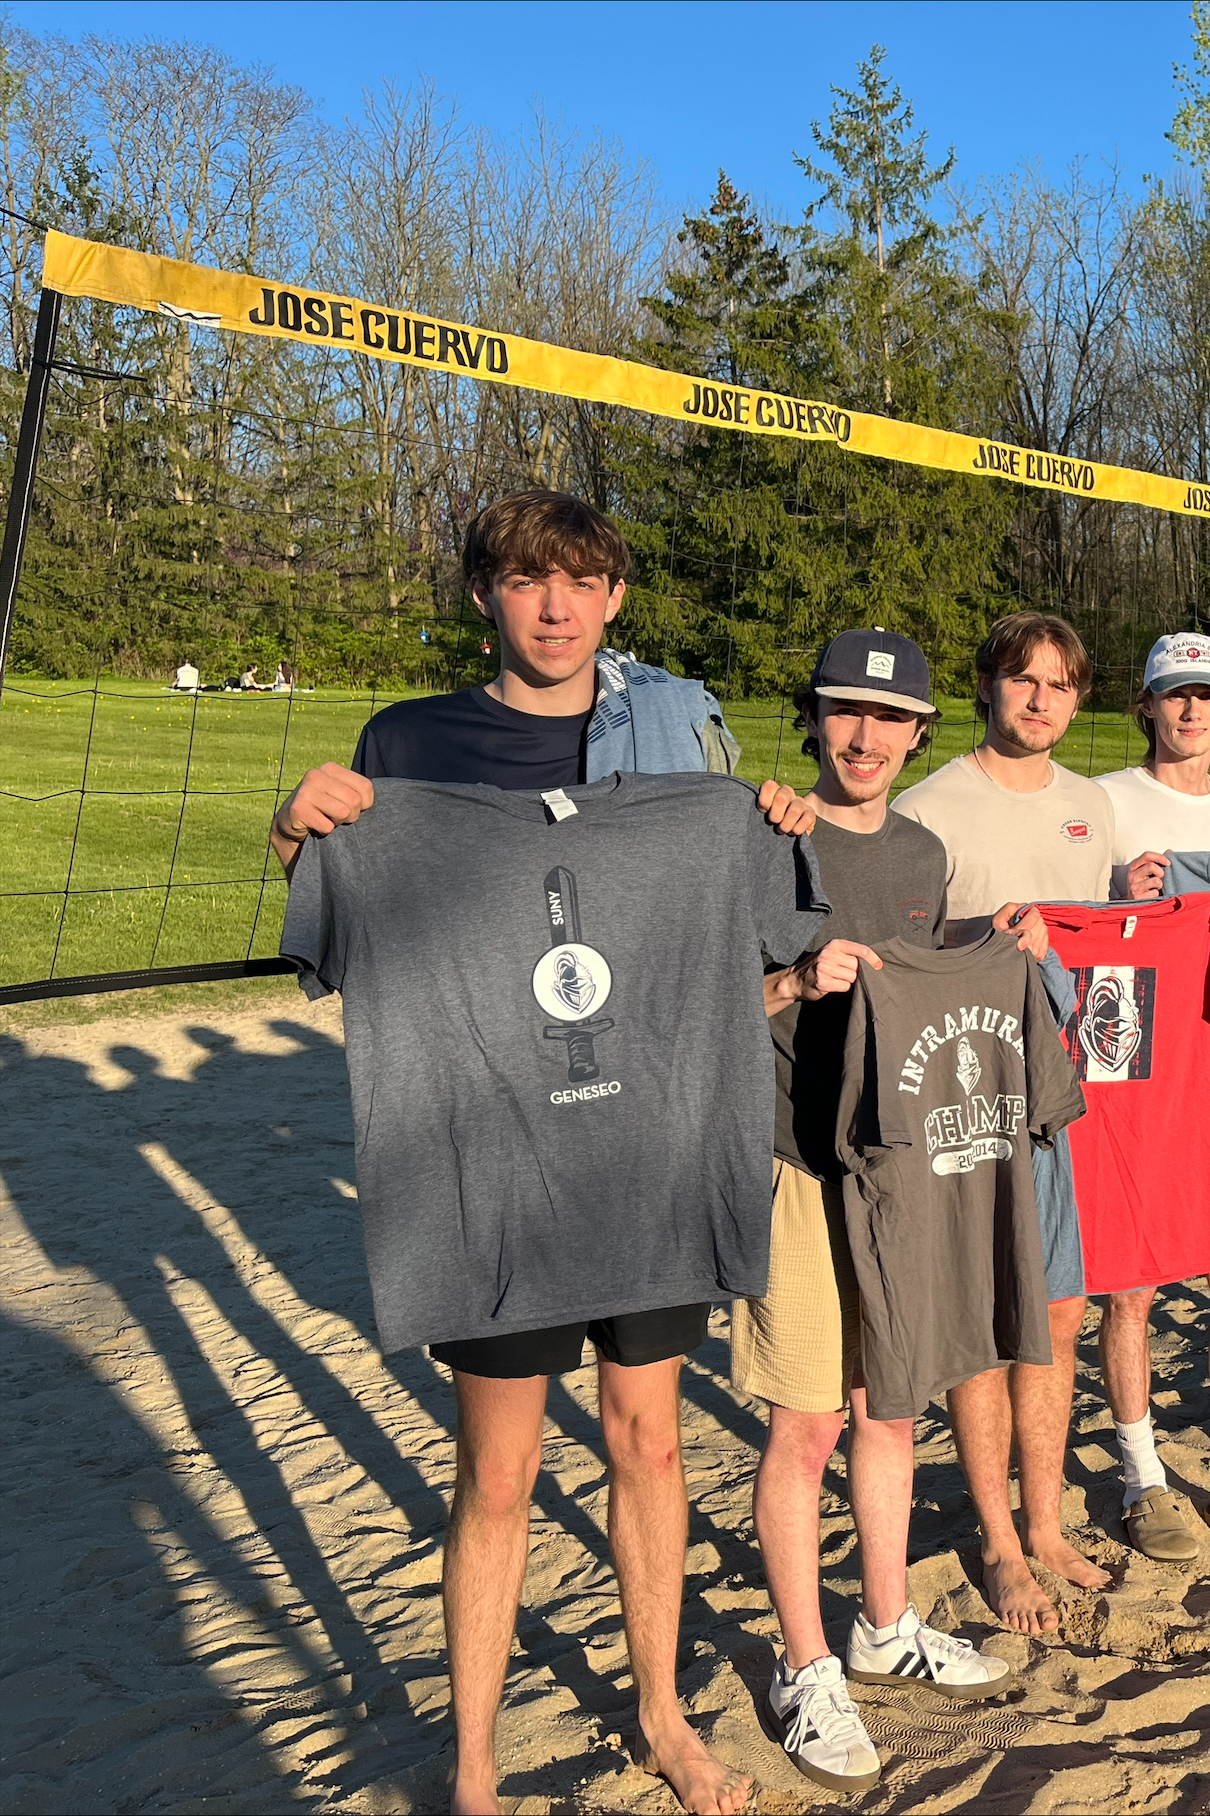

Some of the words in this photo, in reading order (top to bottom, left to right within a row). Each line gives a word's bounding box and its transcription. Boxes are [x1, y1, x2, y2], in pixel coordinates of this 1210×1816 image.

[249, 287, 354, 341] JOSE
[359, 308, 509, 374] CUERVO
[683, 383, 750, 425] JOSE
[756, 396, 851, 442] CUERVO
[973, 444, 1020, 476] JOSE
[1026, 453, 1094, 491] CUERVO
[547, 891, 565, 925] SUNY
[898, 1005, 1026, 1095] INTRAMURA
[550, 1080, 622, 1105] GENESEO
[923, 1093, 1026, 1155] CHMP
